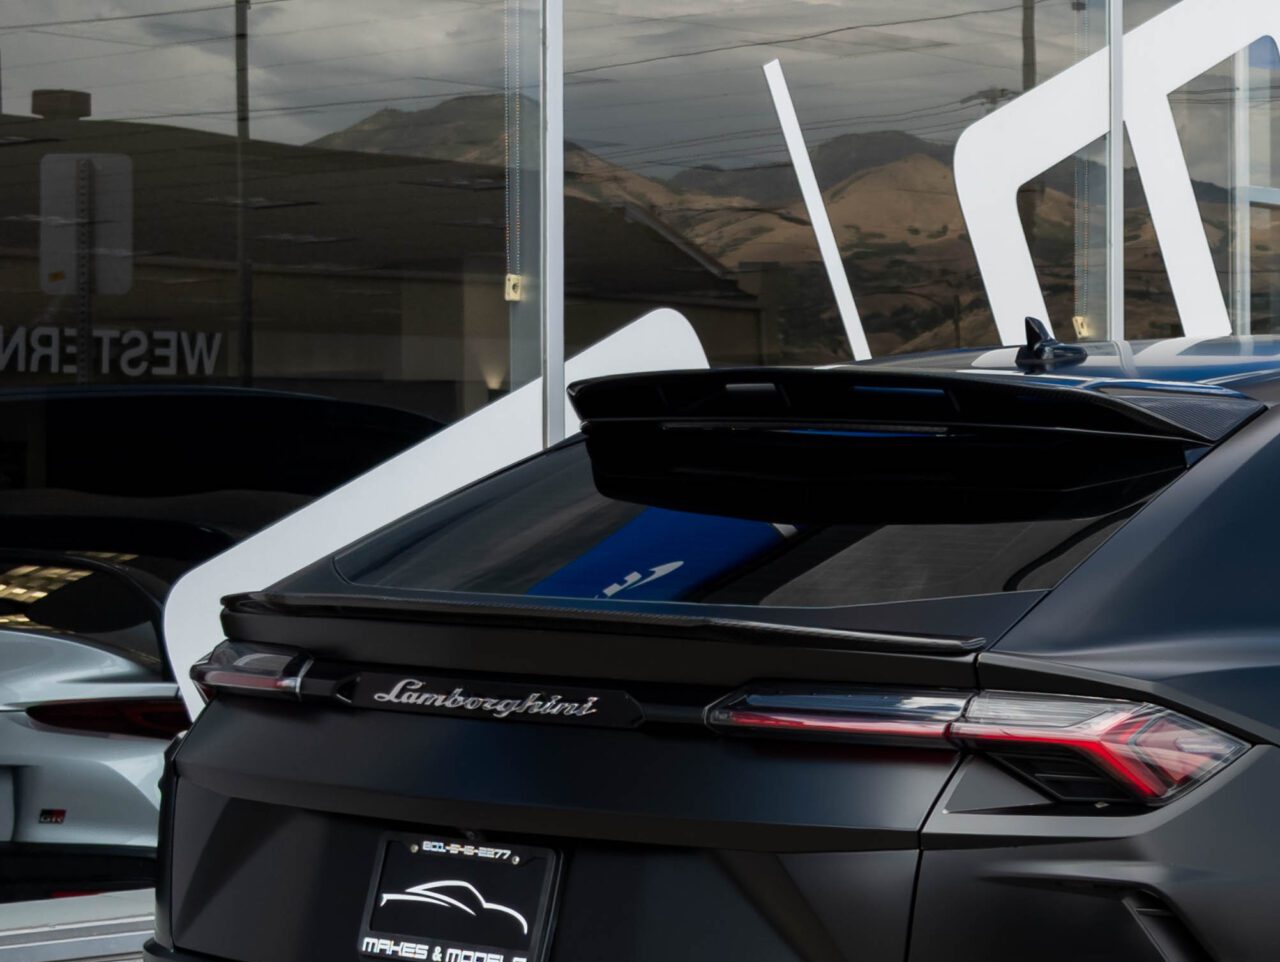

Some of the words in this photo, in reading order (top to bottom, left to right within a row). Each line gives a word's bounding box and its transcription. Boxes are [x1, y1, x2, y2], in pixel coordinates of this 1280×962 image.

[374, 678, 599, 719] Lamborghini
[362, 936, 429, 960] MAKES
[432, 946, 442, 962] &
